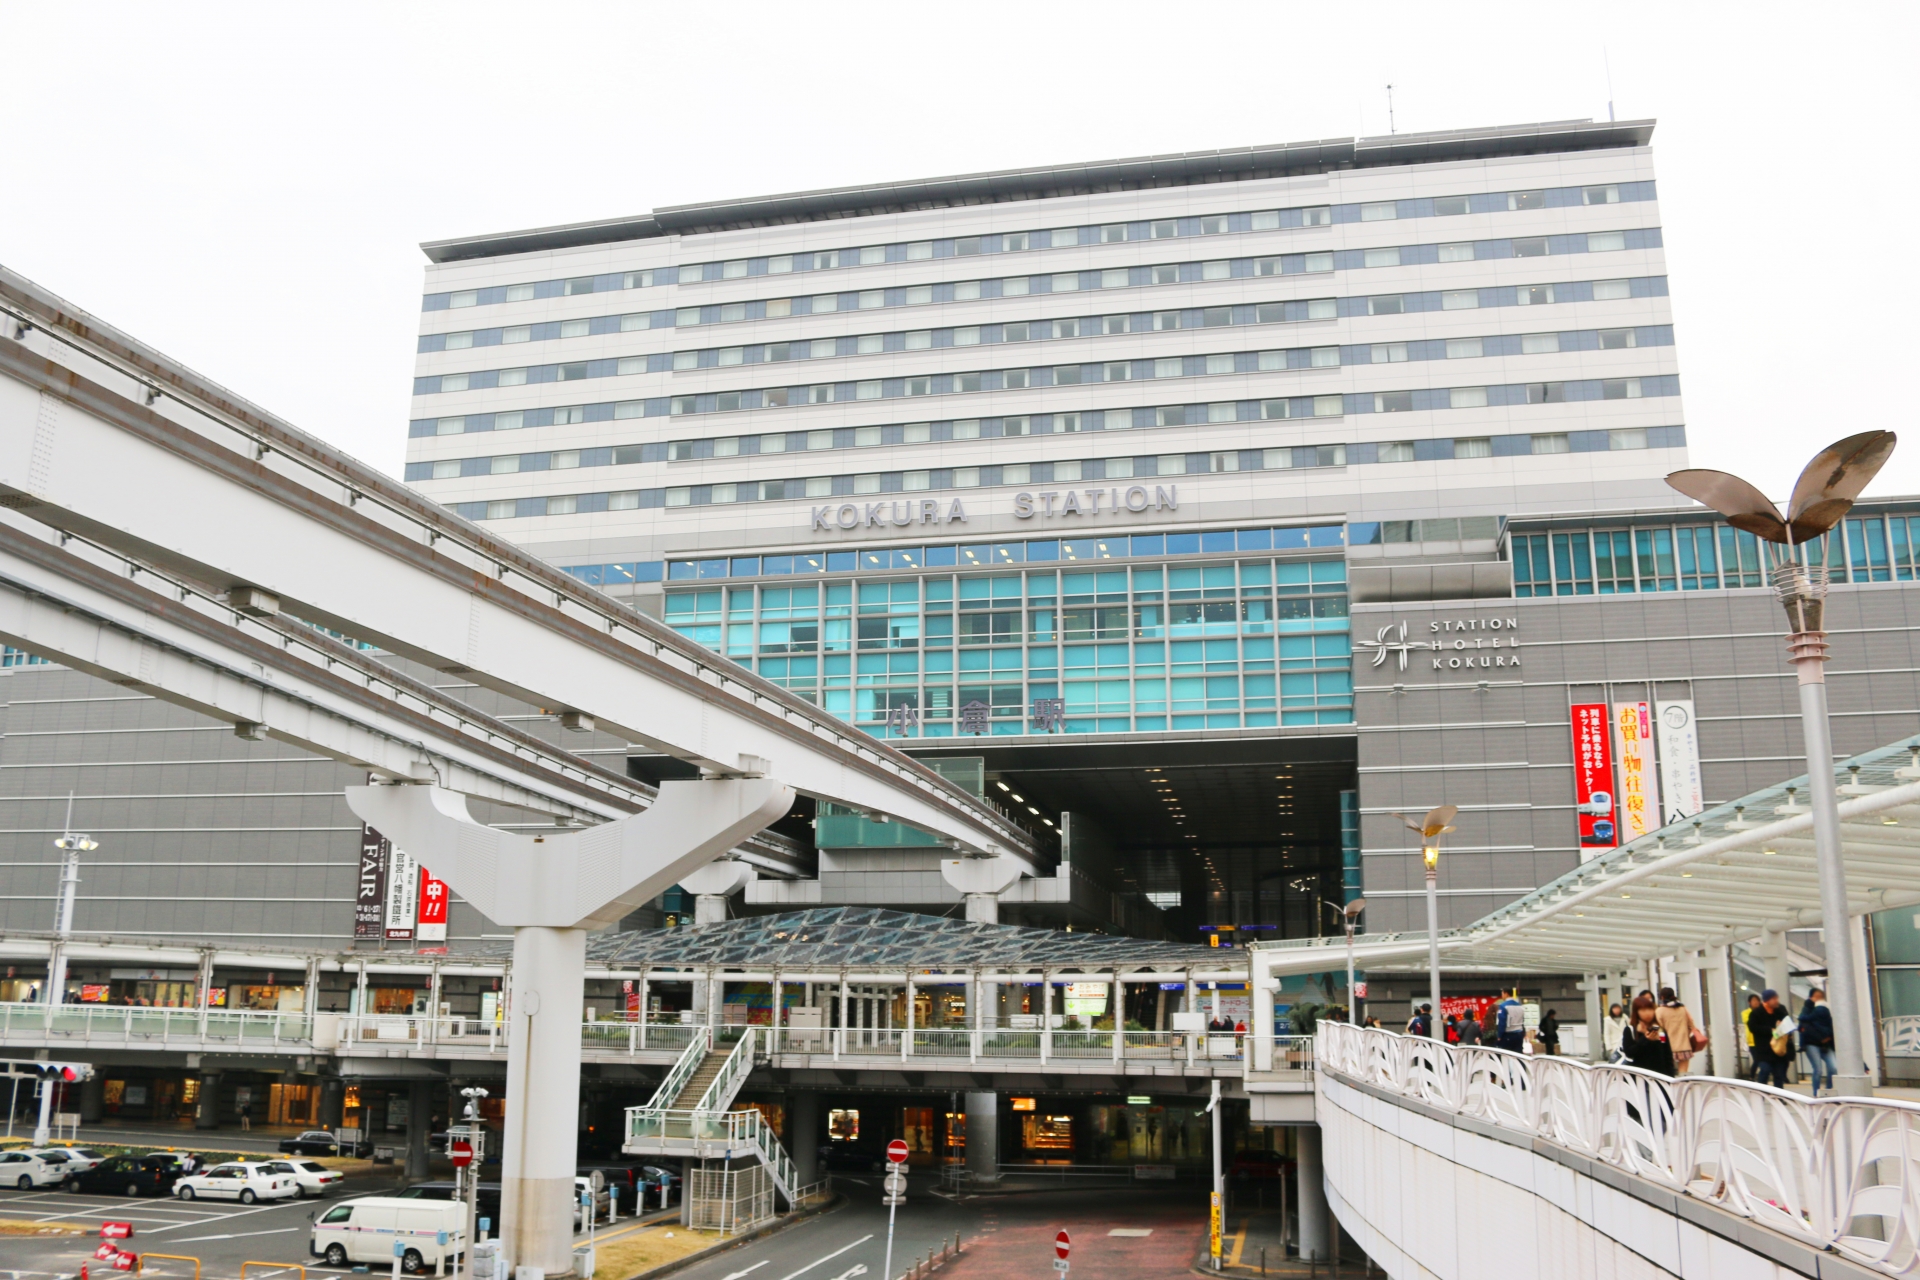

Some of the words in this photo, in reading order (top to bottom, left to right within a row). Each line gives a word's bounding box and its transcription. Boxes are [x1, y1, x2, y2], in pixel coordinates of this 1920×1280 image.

[811, 498, 968, 530] KOKURA
[1014, 484, 1178, 519] STATION
[1430, 618, 1517, 632] STATION
[1432, 637, 1519, 650] HOTEL
[1433, 656, 1520, 669] KOKURA
[886, 698, 1066, 735] 小倉駅
[1590, 708, 1603, 769] 列車に乗るなら
[361, 844, 379, 898] FAIR
